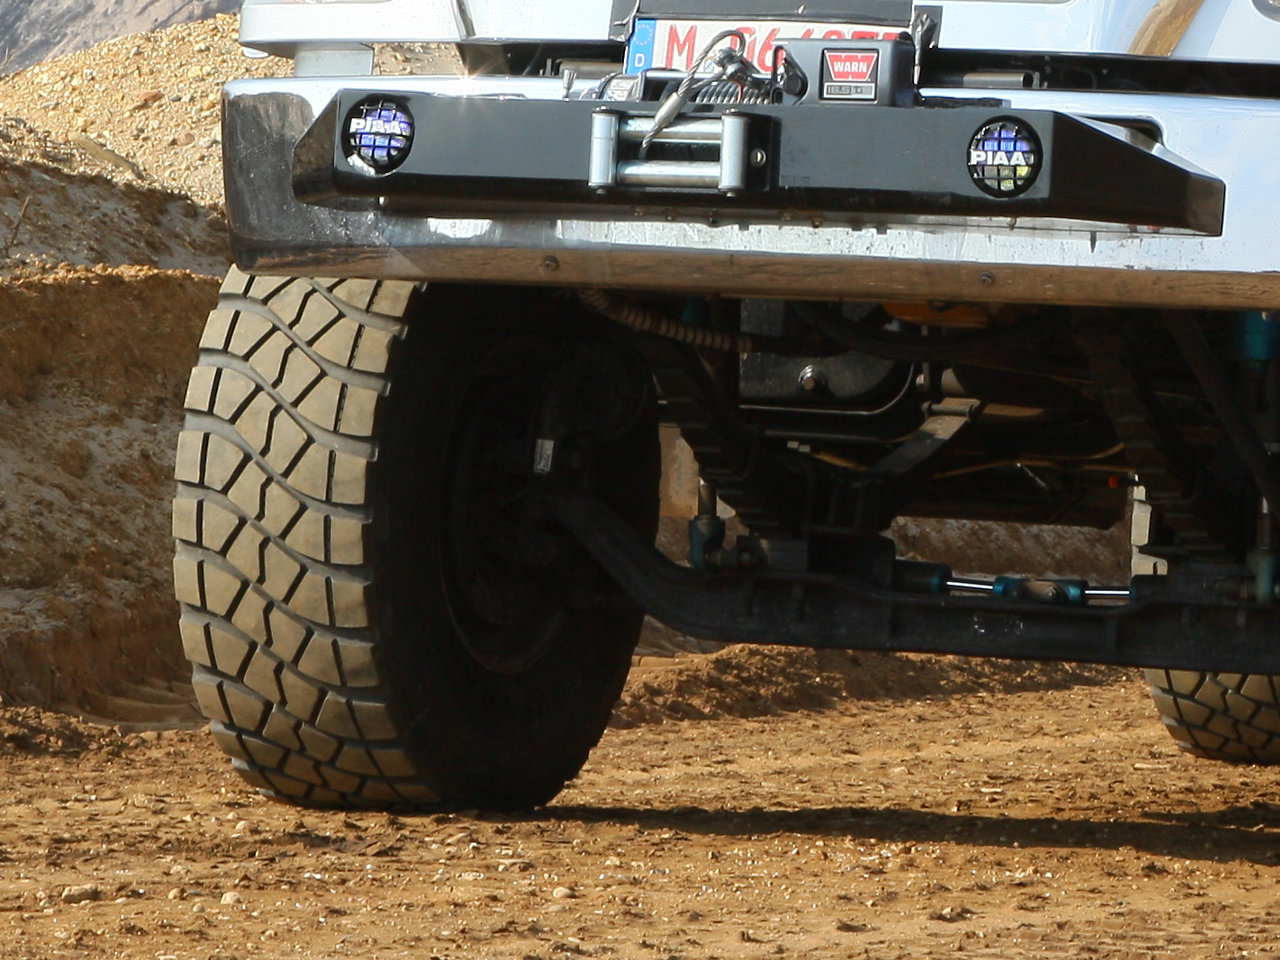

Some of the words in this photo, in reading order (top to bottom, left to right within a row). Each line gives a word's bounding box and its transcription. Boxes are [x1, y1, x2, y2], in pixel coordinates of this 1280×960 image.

[665, 25, 698, 71] M
[634, 53, 646, 68] D
[833, 61, 868, 73] WARN
[349, 117, 401, 135] PIAA
[969, 150, 1026, 166] PIAA
